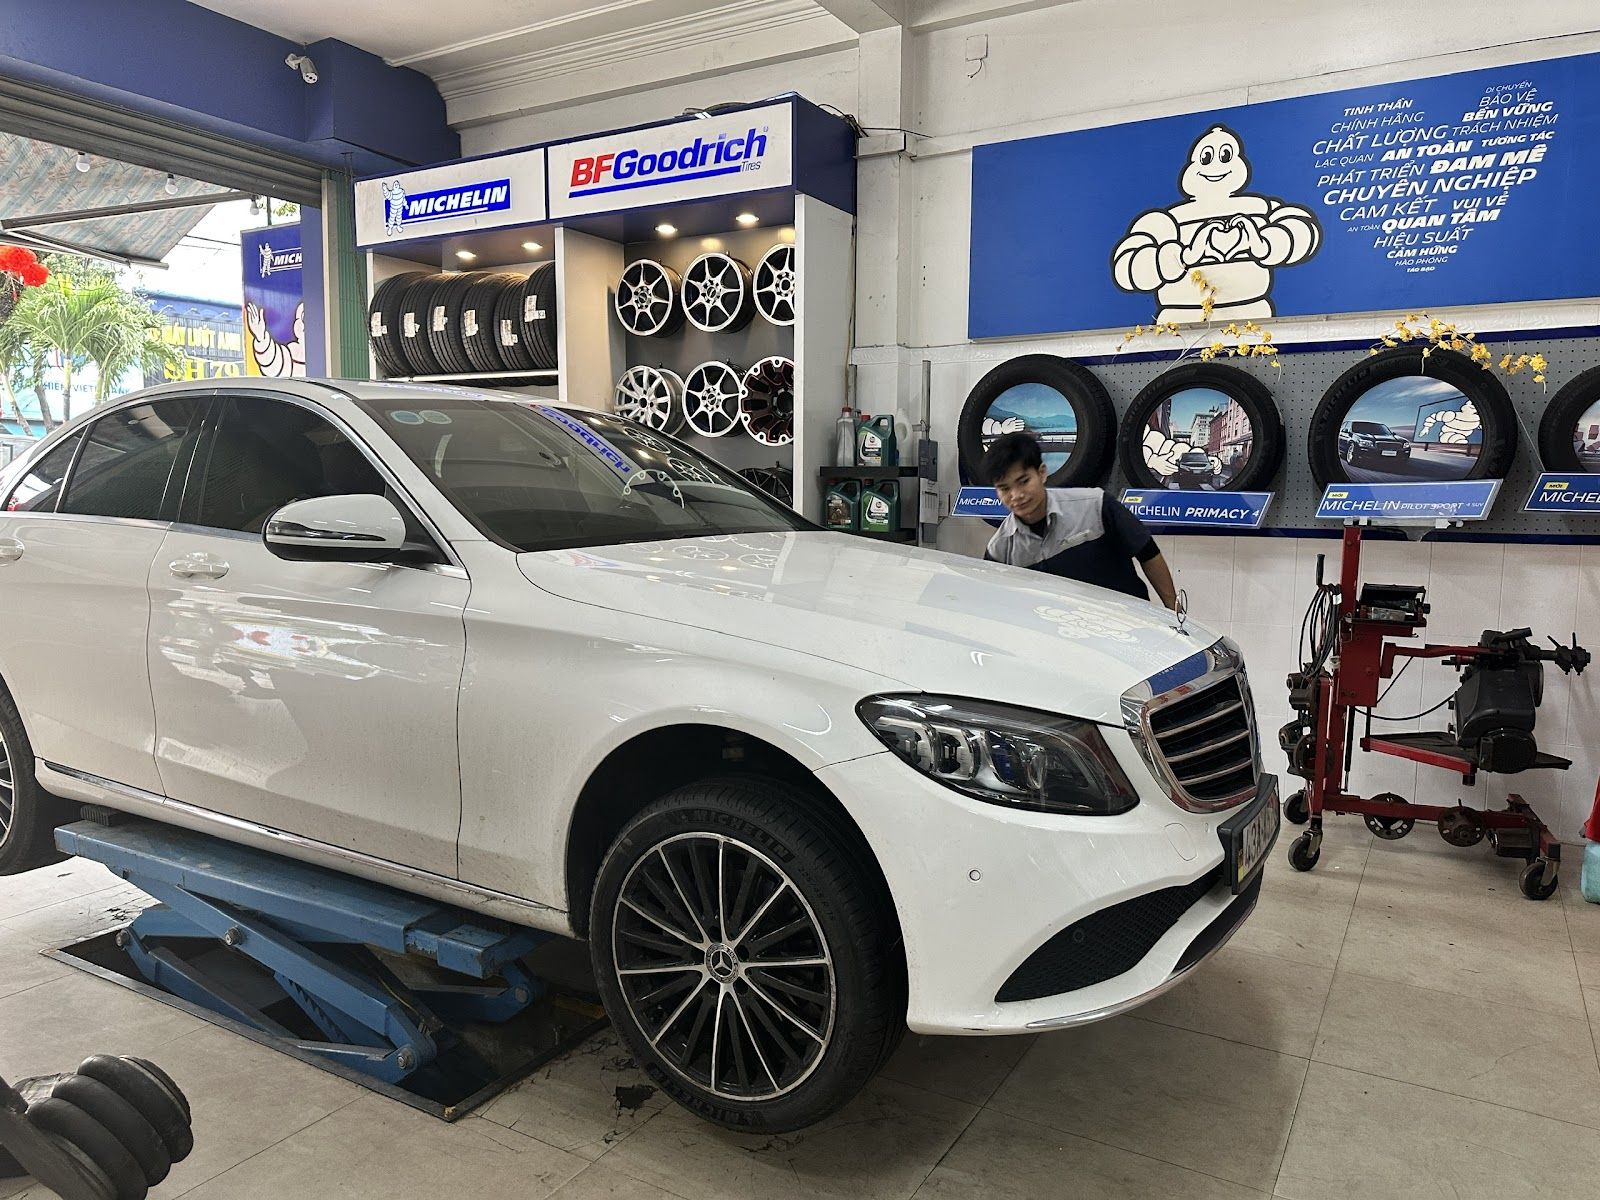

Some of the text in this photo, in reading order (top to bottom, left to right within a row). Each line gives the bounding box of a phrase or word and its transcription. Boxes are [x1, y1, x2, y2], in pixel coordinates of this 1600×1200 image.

[1344, 98, 1413, 116] TINH THẦN
[1479, 87, 1537, 107] BẢO VỆ
[1462, 101, 1553, 122] BỀN VỮNG
[1331, 111, 1425, 133] CHÍNH HÃNG
[1452, 113, 1559, 136] TRÁCH NHIỆM
[1312, 125, 1449, 155] CHẤT LƯỢNG
[1482, 131, 1555, 147] TƯƠNG TÁC
[570, 127, 767, 188] BFGoodrich
[1315, 153, 1374, 168] LẠC QUAN
[1380, 139, 1473, 162] AN TOÀN
[1429, 143, 1547, 174] ĐAM MÊ
[741, 159, 762, 173] Tires
[1317, 159, 1425, 187] PHÁT TRIỂN
[1323, 166, 1537, 205] CHUYÊN NGHIỆP
[407, 184, 508, 217] MICHELIN
[1340, 195, 1438, 220] CAM KẾT
[1453, 191, 1509, 210] VUI VẺ
[1381, 208, 1501, 234] QUAN TÂM
[1373, 224, 1474, 249] HIỆU SUẤT
[273, 252, 302, 266] MICH
[1386, 246, 1417, 259] CẢM
[1394, 258, 1414, 267] HÀO
[958, 497, 1003, 506] MICHELIN
[1322, 500, 1400, 511] MICHELIN
[1400, 502, 1430, 510] PILOT
[1538, 491, 1600, 503] MICHE
[1184, 506, 1250, 520] PRIMACY
[1252, 509, 1260, 517] 4
